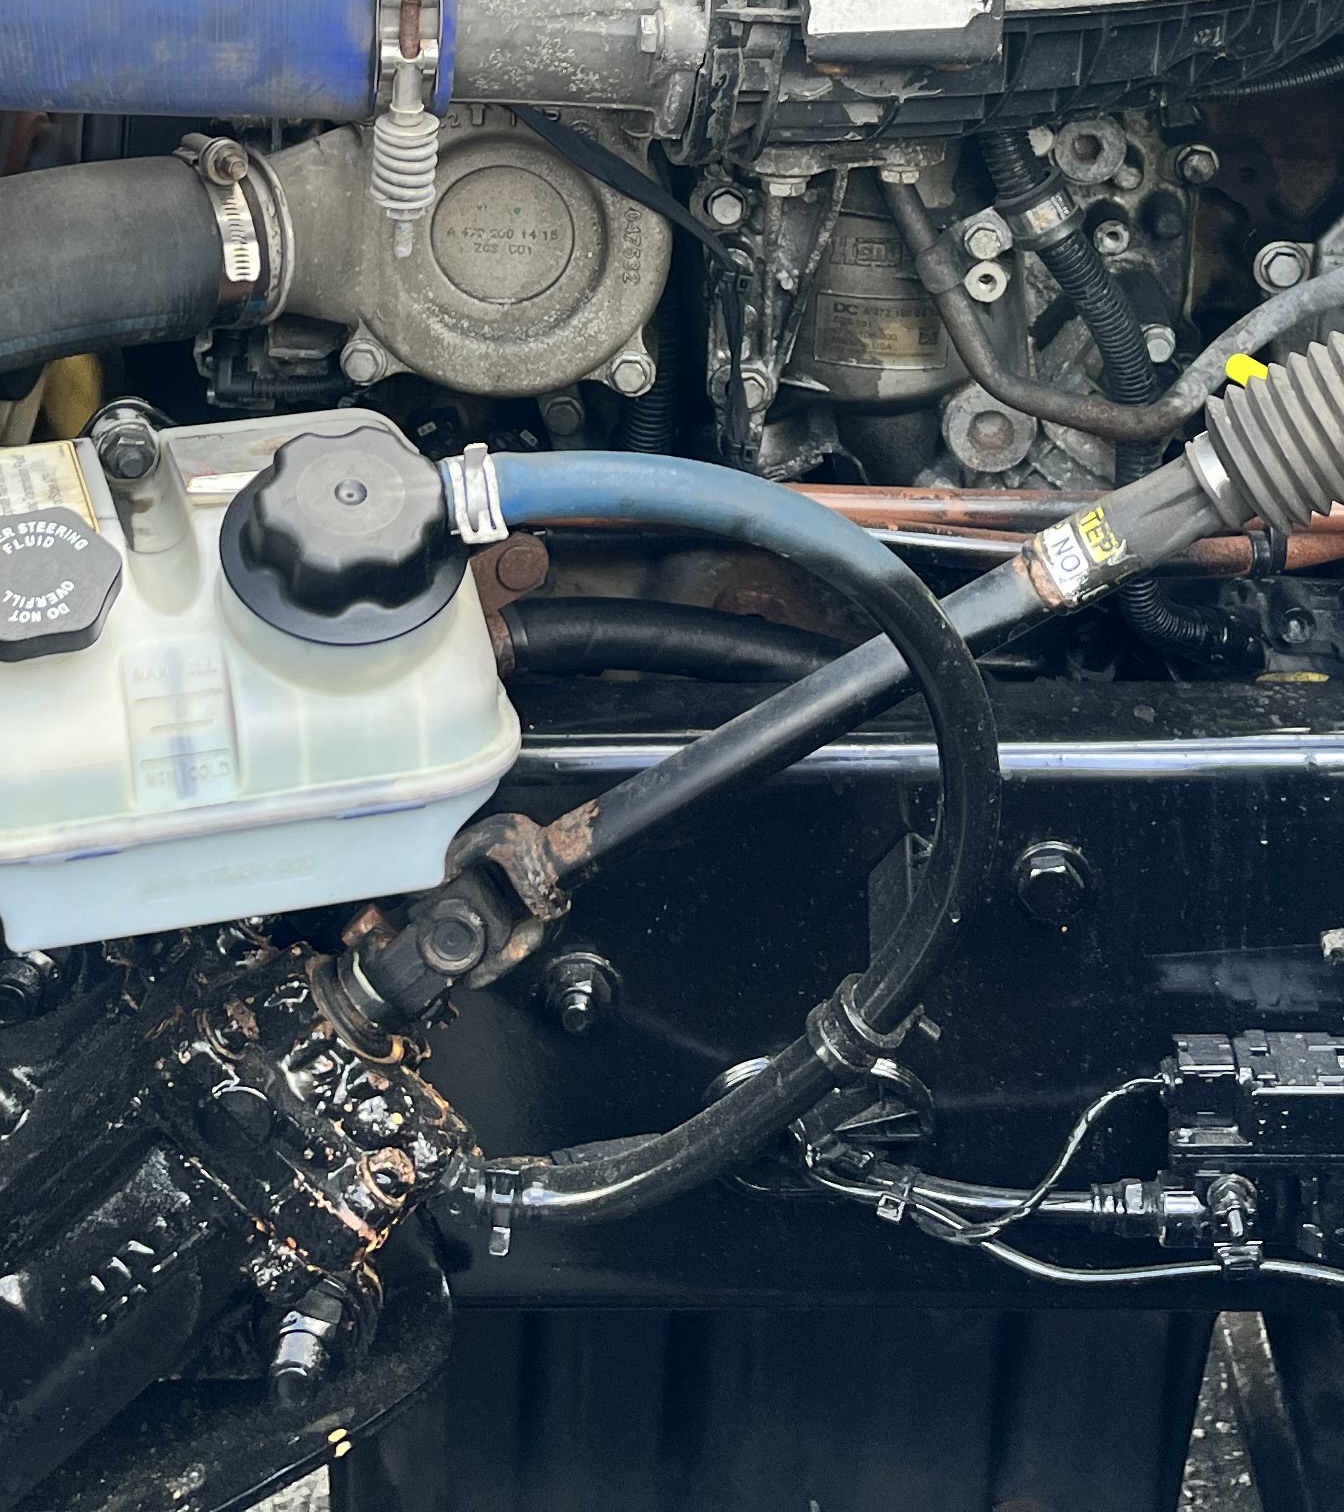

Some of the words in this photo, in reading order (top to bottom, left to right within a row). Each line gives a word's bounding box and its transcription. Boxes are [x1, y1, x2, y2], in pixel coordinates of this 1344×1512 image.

[833, 302, 859, 315] DC
[2, 534, 55, 555] FLUID
[16, 521, 89, 551] STEERING
[1, 580, 75, 610] OVERFILL
[7, 609, 42, 624] NOT
[46, 602, 71, 620] DO
[189, 761, 232, 780] COLD
